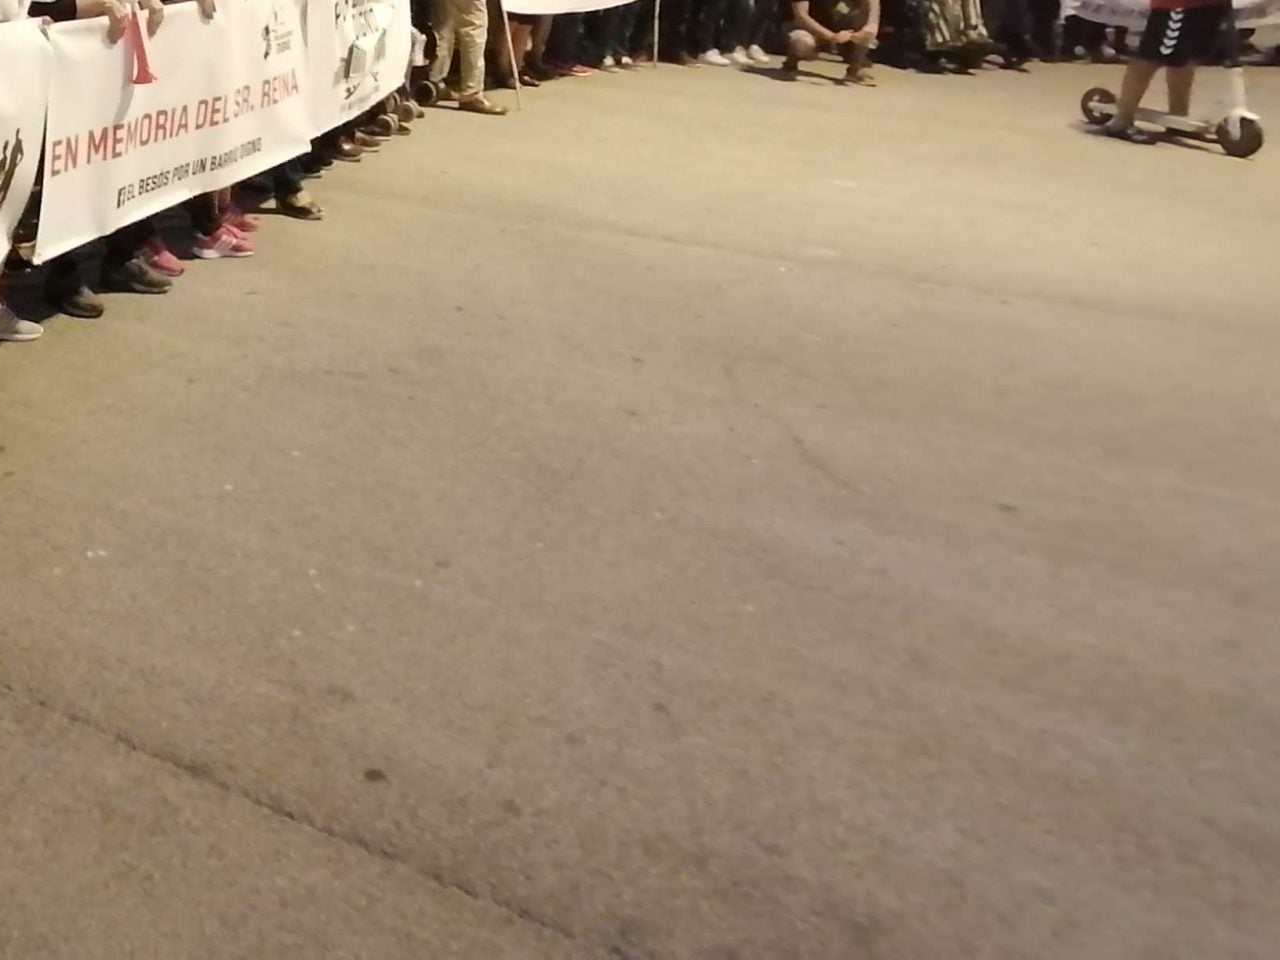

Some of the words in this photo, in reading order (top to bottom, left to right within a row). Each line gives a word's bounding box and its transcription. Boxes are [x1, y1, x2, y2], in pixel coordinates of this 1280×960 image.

[50, 134, 79, 178] EN
[86, 104, 189, 164] MEMORIA
[195, 95, 230, 131] DEL
[233, 85, 255, 119] SR.
[260, 68, 299, 109] REINA
[171, 162, 190, 183] POR
[192, 157, 207, 176] UN
